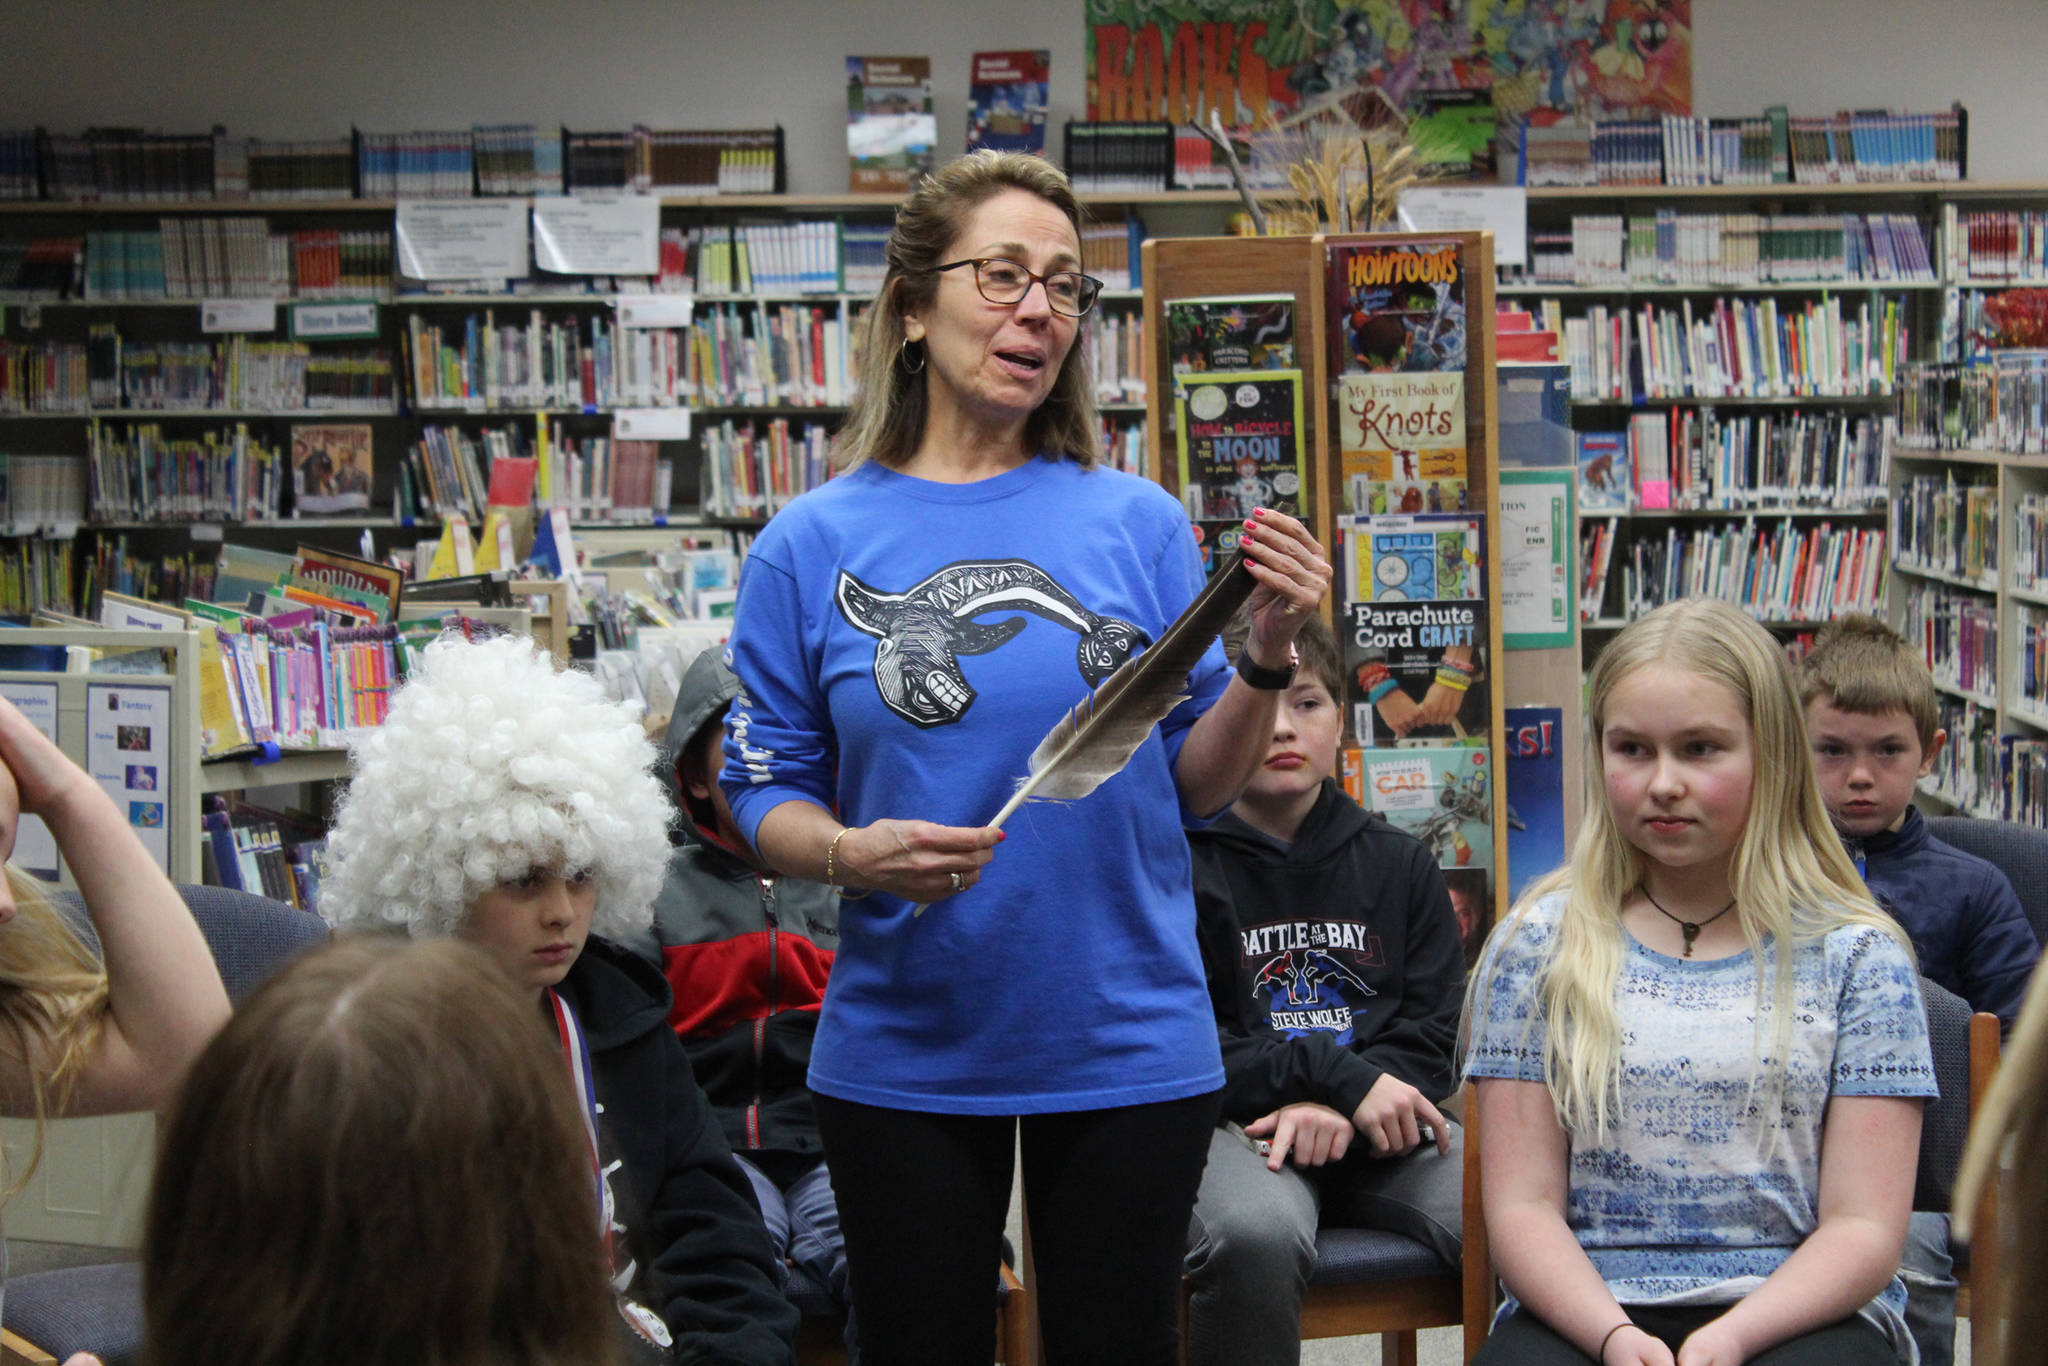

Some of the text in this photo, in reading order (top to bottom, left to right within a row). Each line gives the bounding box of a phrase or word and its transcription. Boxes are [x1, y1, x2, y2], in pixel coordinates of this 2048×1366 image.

[1094, 21, 1267, 132] BOOKS
[1348, 249, 1457, 287] HOWTOONS
[1348, 382, 1456, 399] My First Book of
[1349, 400, 1452, 451] Knots
[1213, 437, 1280, 462] MOON
[1355, 604, 1474, 626] Parachute
[1355, 625, 1475, 648] Cord CRAFT
[1377, 773, 1427, 794] CAR
[1310, 933, 1327, 946] THE
[1311, 924, 1322, 935] AT
[1325, 922, 1367, 951] BAY
[1270, 1011, 1306, 1028] STEVE
[1307, 1006, 1352, 1027] WOLFE
